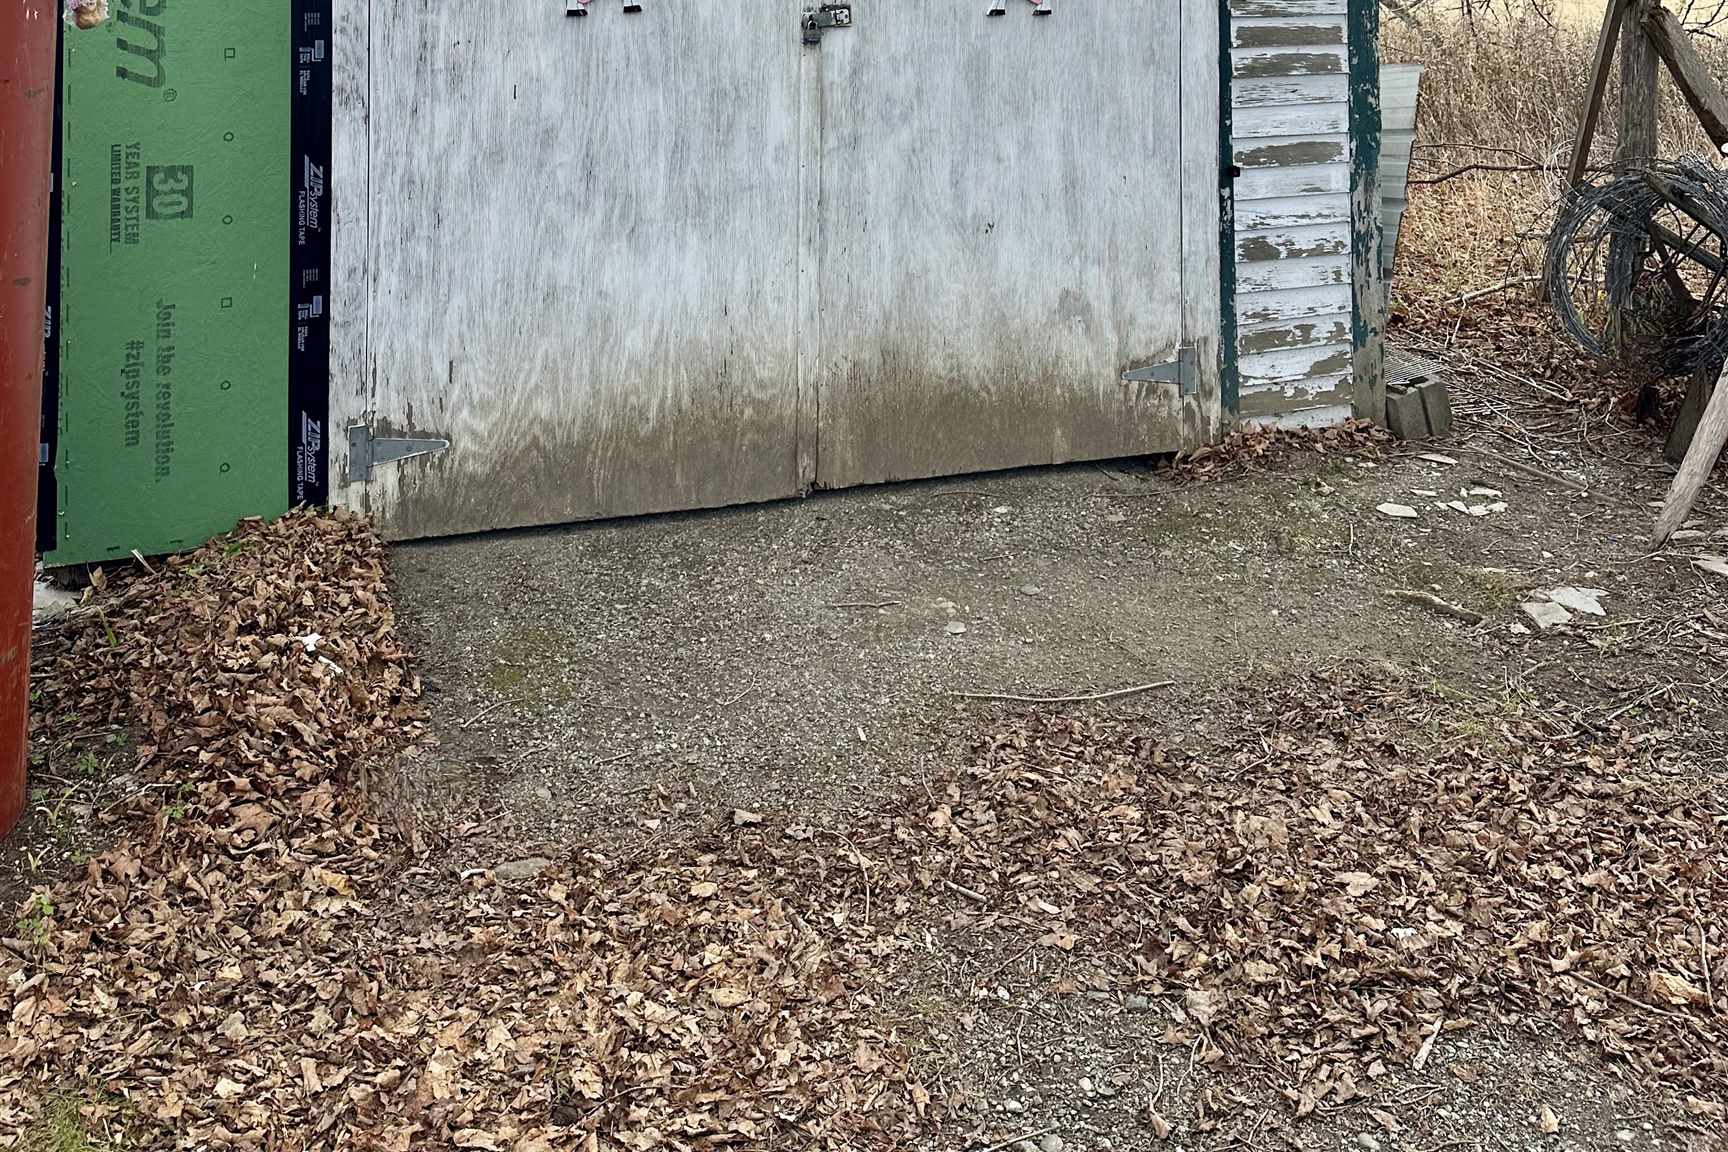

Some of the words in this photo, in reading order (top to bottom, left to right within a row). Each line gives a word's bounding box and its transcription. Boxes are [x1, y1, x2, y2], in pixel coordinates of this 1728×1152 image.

[110, 144, 121, 185] LIMITED
[124, 141, 140, 180] YEAR
[152, 170, 189, 216] 30
[298, 190, 306, 225] FLASHING
[110, 187, 121, 243] WARRANTY
[124, 186, 140, 245] SYSTEM
[298, 227, 306, 246] TAPE
[156, 298, 176, 339] Join
[156, 345, 176, 377] the
[120, 339, 144, 448] #zipsystem
[155, 382, 175, 484] revolution.
[296, 446, 304, 481] FLASHING
[296, 483, 304, 500] TAPE
